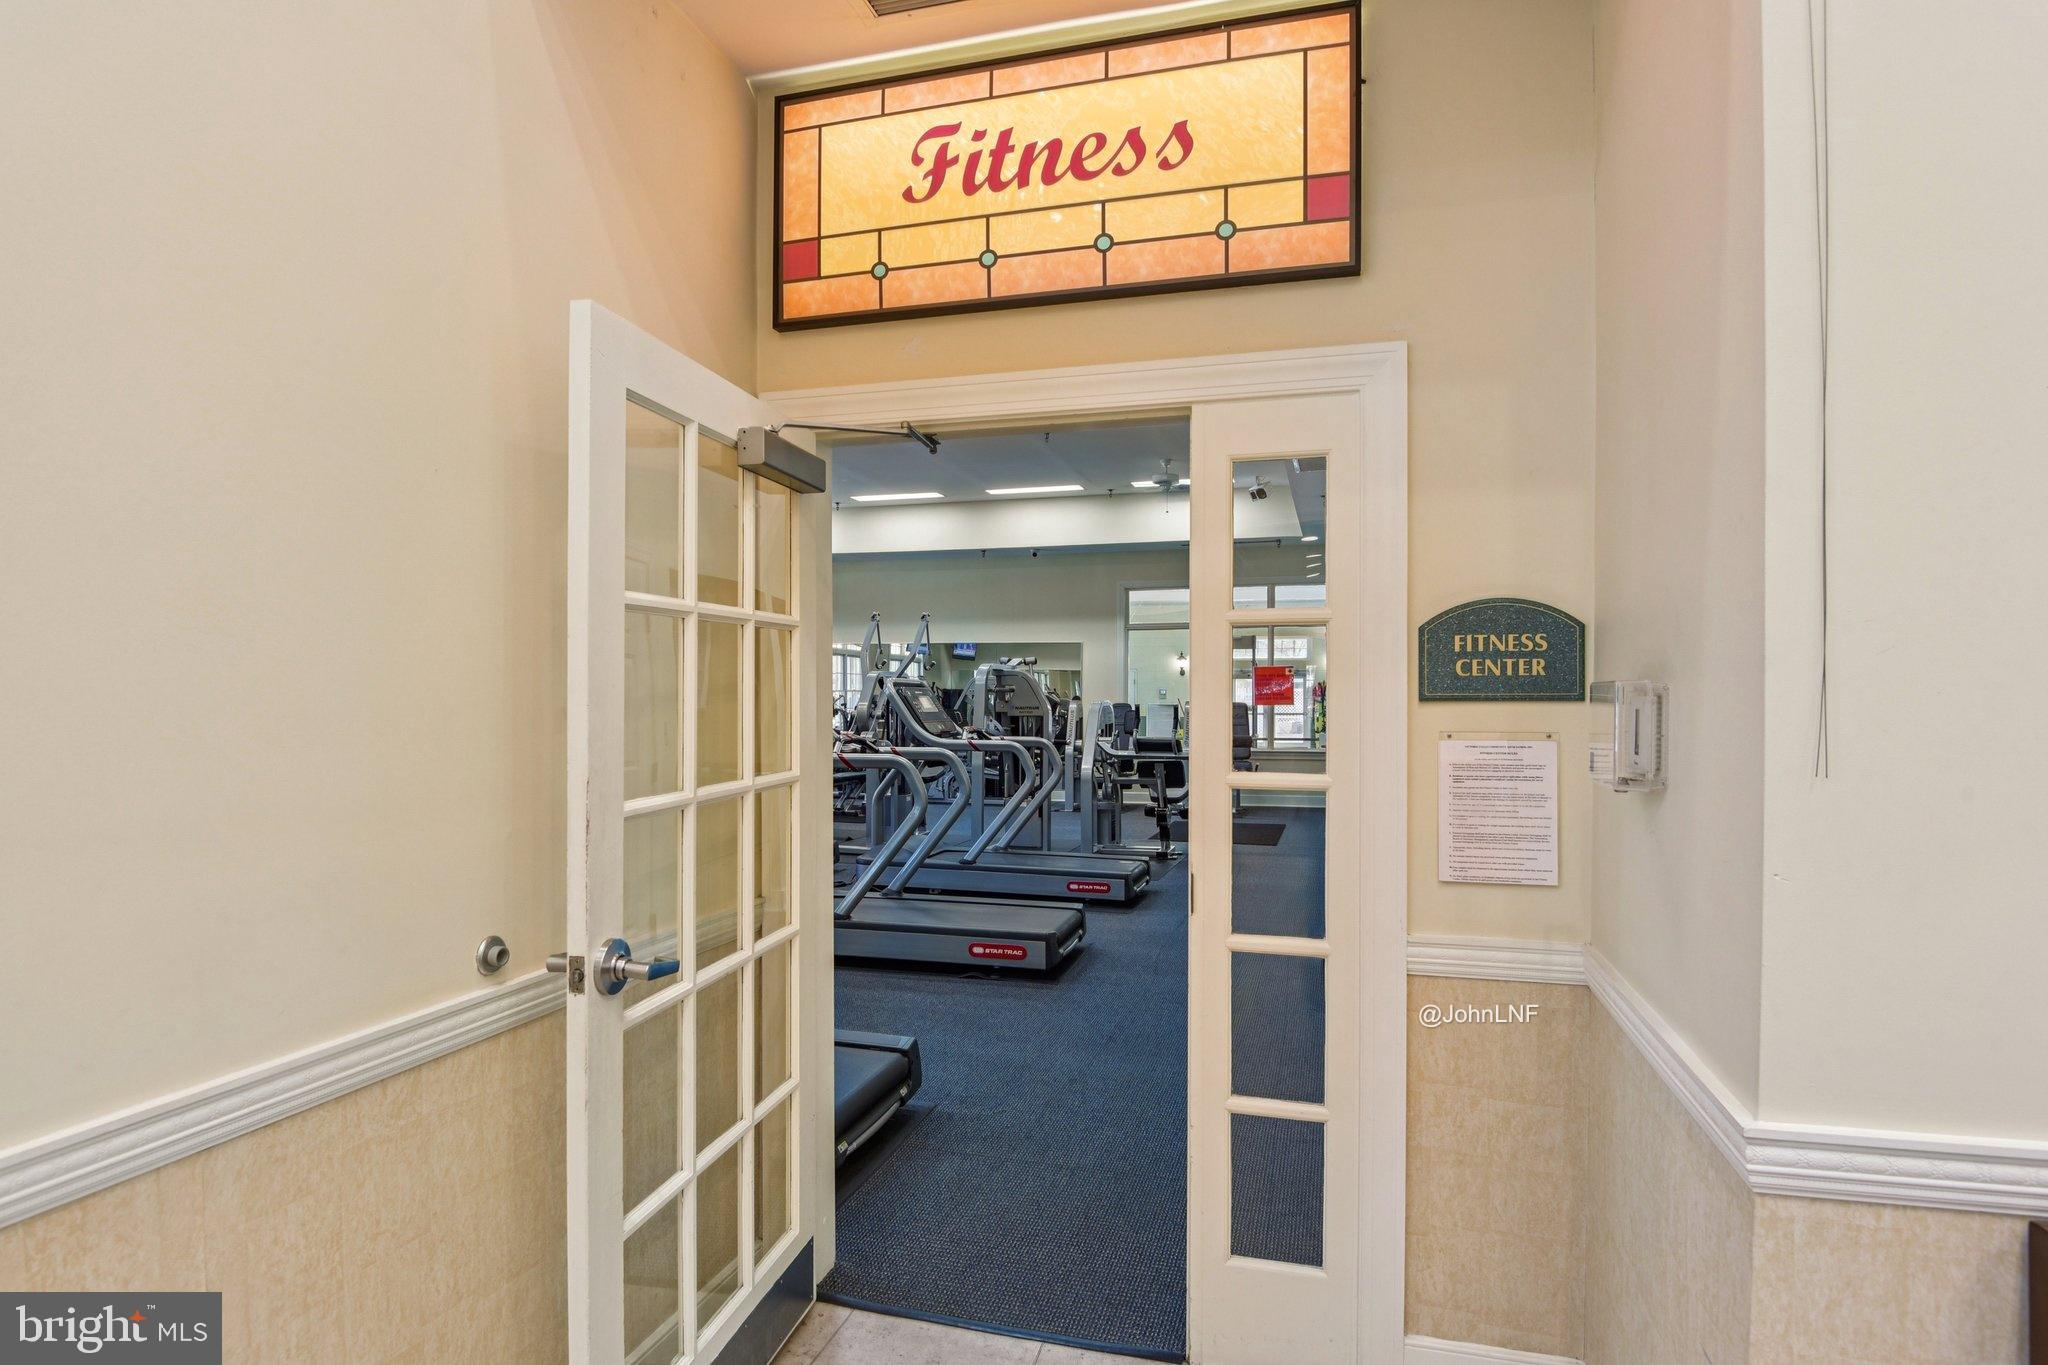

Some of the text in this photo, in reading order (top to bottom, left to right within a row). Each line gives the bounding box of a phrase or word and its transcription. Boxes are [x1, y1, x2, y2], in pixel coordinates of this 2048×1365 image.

[902, 120, 1194, 204] Fitness
[1454, 633, 1548, 652] FITNESS
[1455, 658, 1546, 677] CENTER
